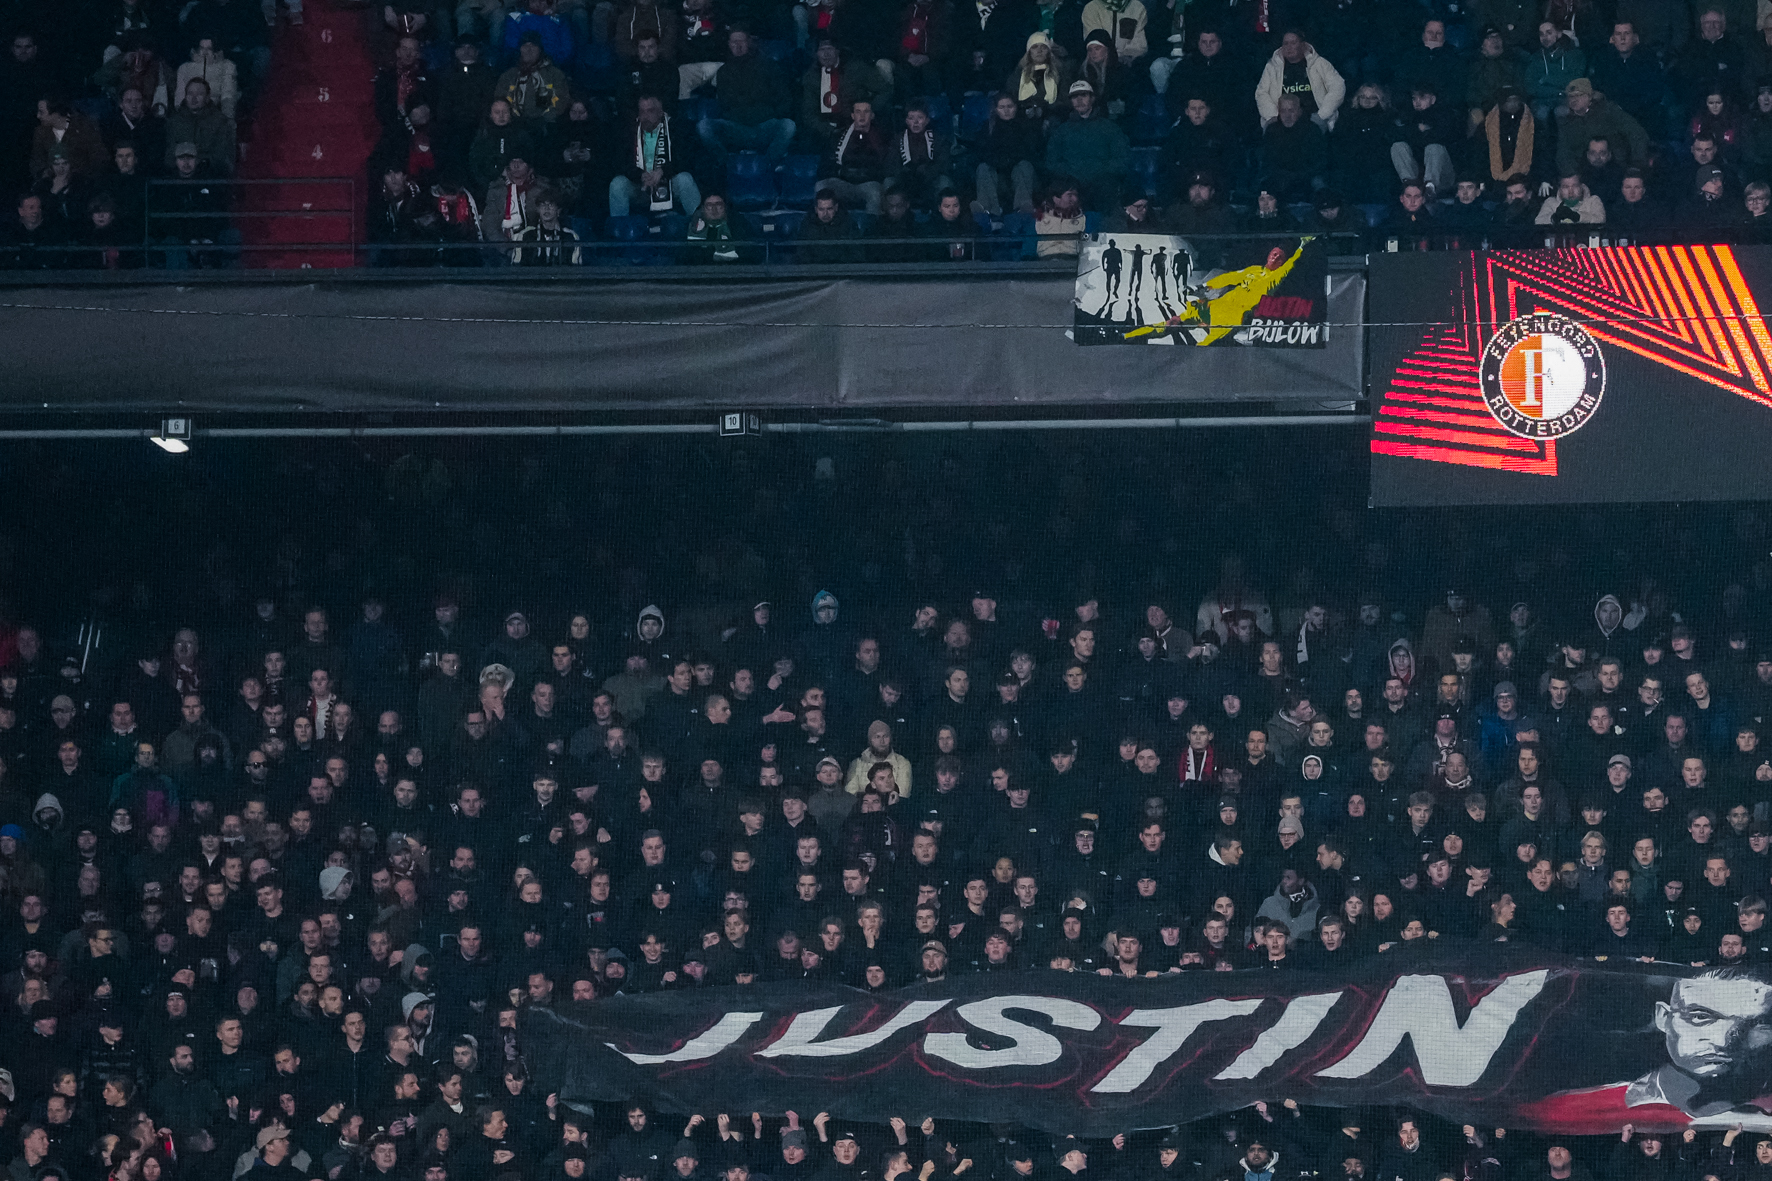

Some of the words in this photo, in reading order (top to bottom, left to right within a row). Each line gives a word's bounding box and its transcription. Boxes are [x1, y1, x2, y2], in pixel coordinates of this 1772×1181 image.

[1249, 318, 1320, 344] BIJLOW
[1490, 317, 1594, 361] FEYENOORD
[1489, 394, 1596, 436] ROTTERDAM
[603, 968, 1548, 1093] JUSTIN
